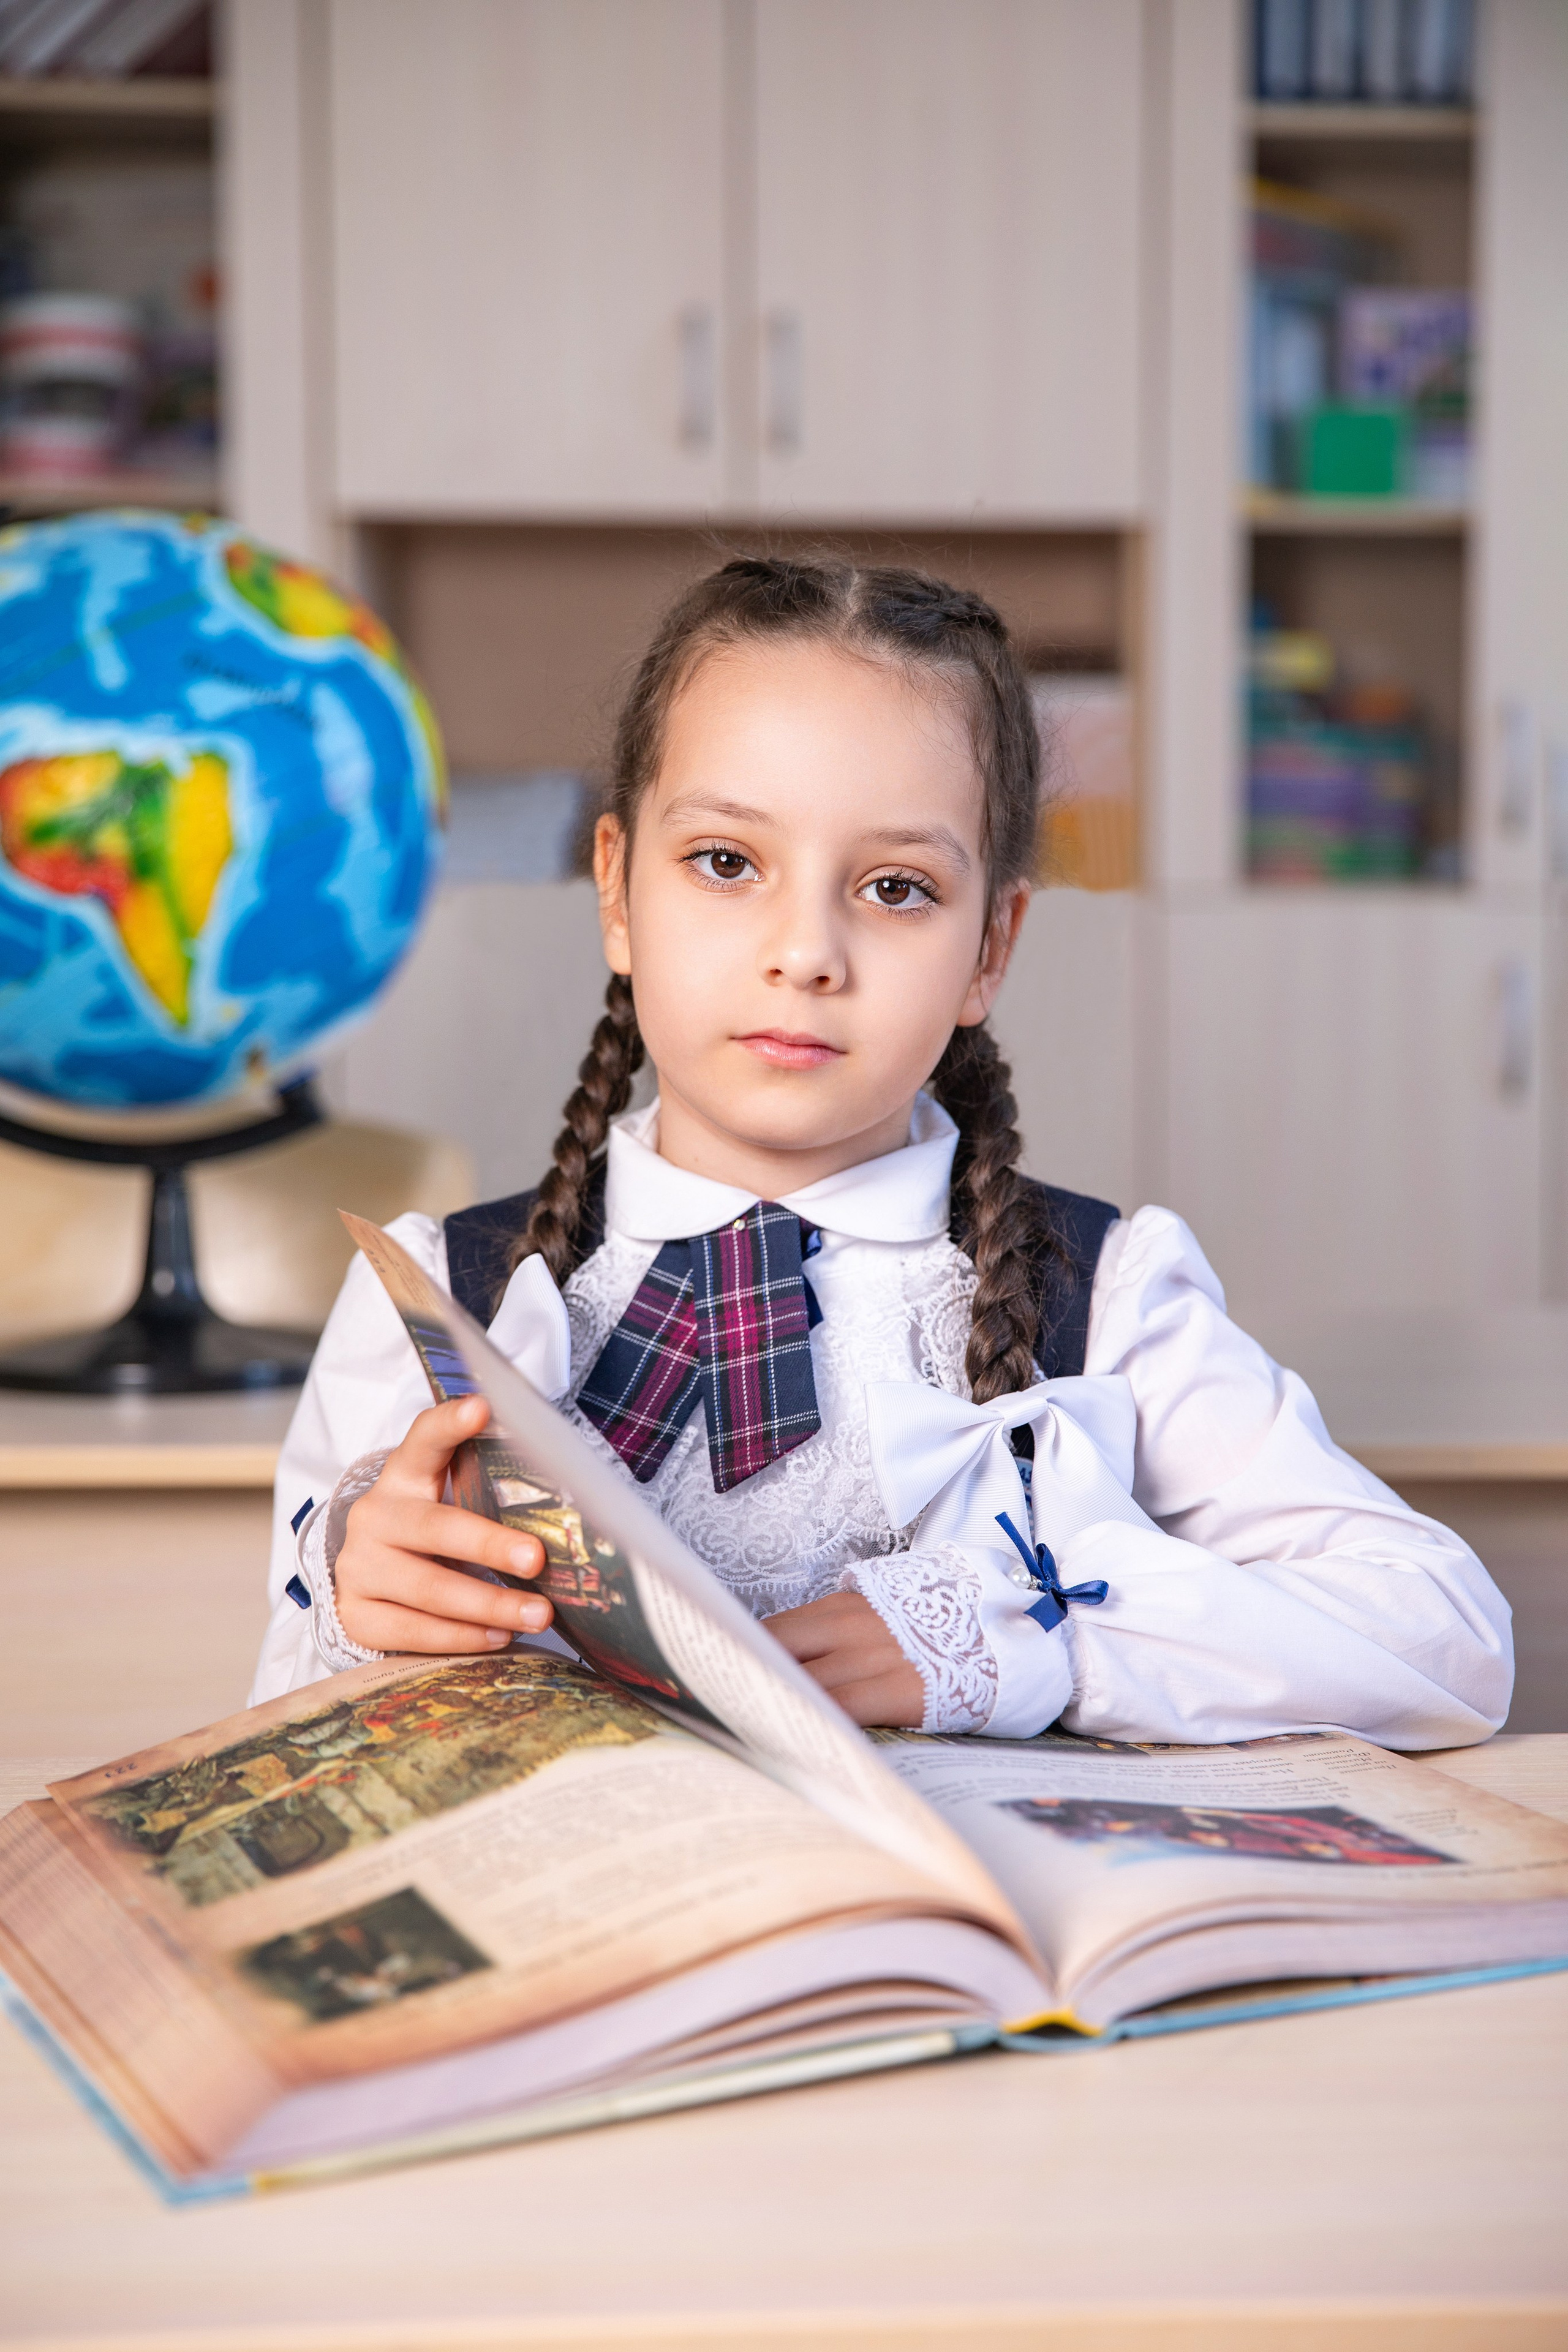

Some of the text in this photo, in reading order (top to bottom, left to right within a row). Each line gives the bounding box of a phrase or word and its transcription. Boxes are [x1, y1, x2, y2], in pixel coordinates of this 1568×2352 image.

[362, 1657, 450, 1684] Соляной бунт
[1302, 1749, 1354, 1758] Романова
[1305, 1752, 1371, 1762] Фёдоровича
[1323, 1757, 1373, 1766] Михаила
[1339, 1765, 1398, 1774] Призвание
